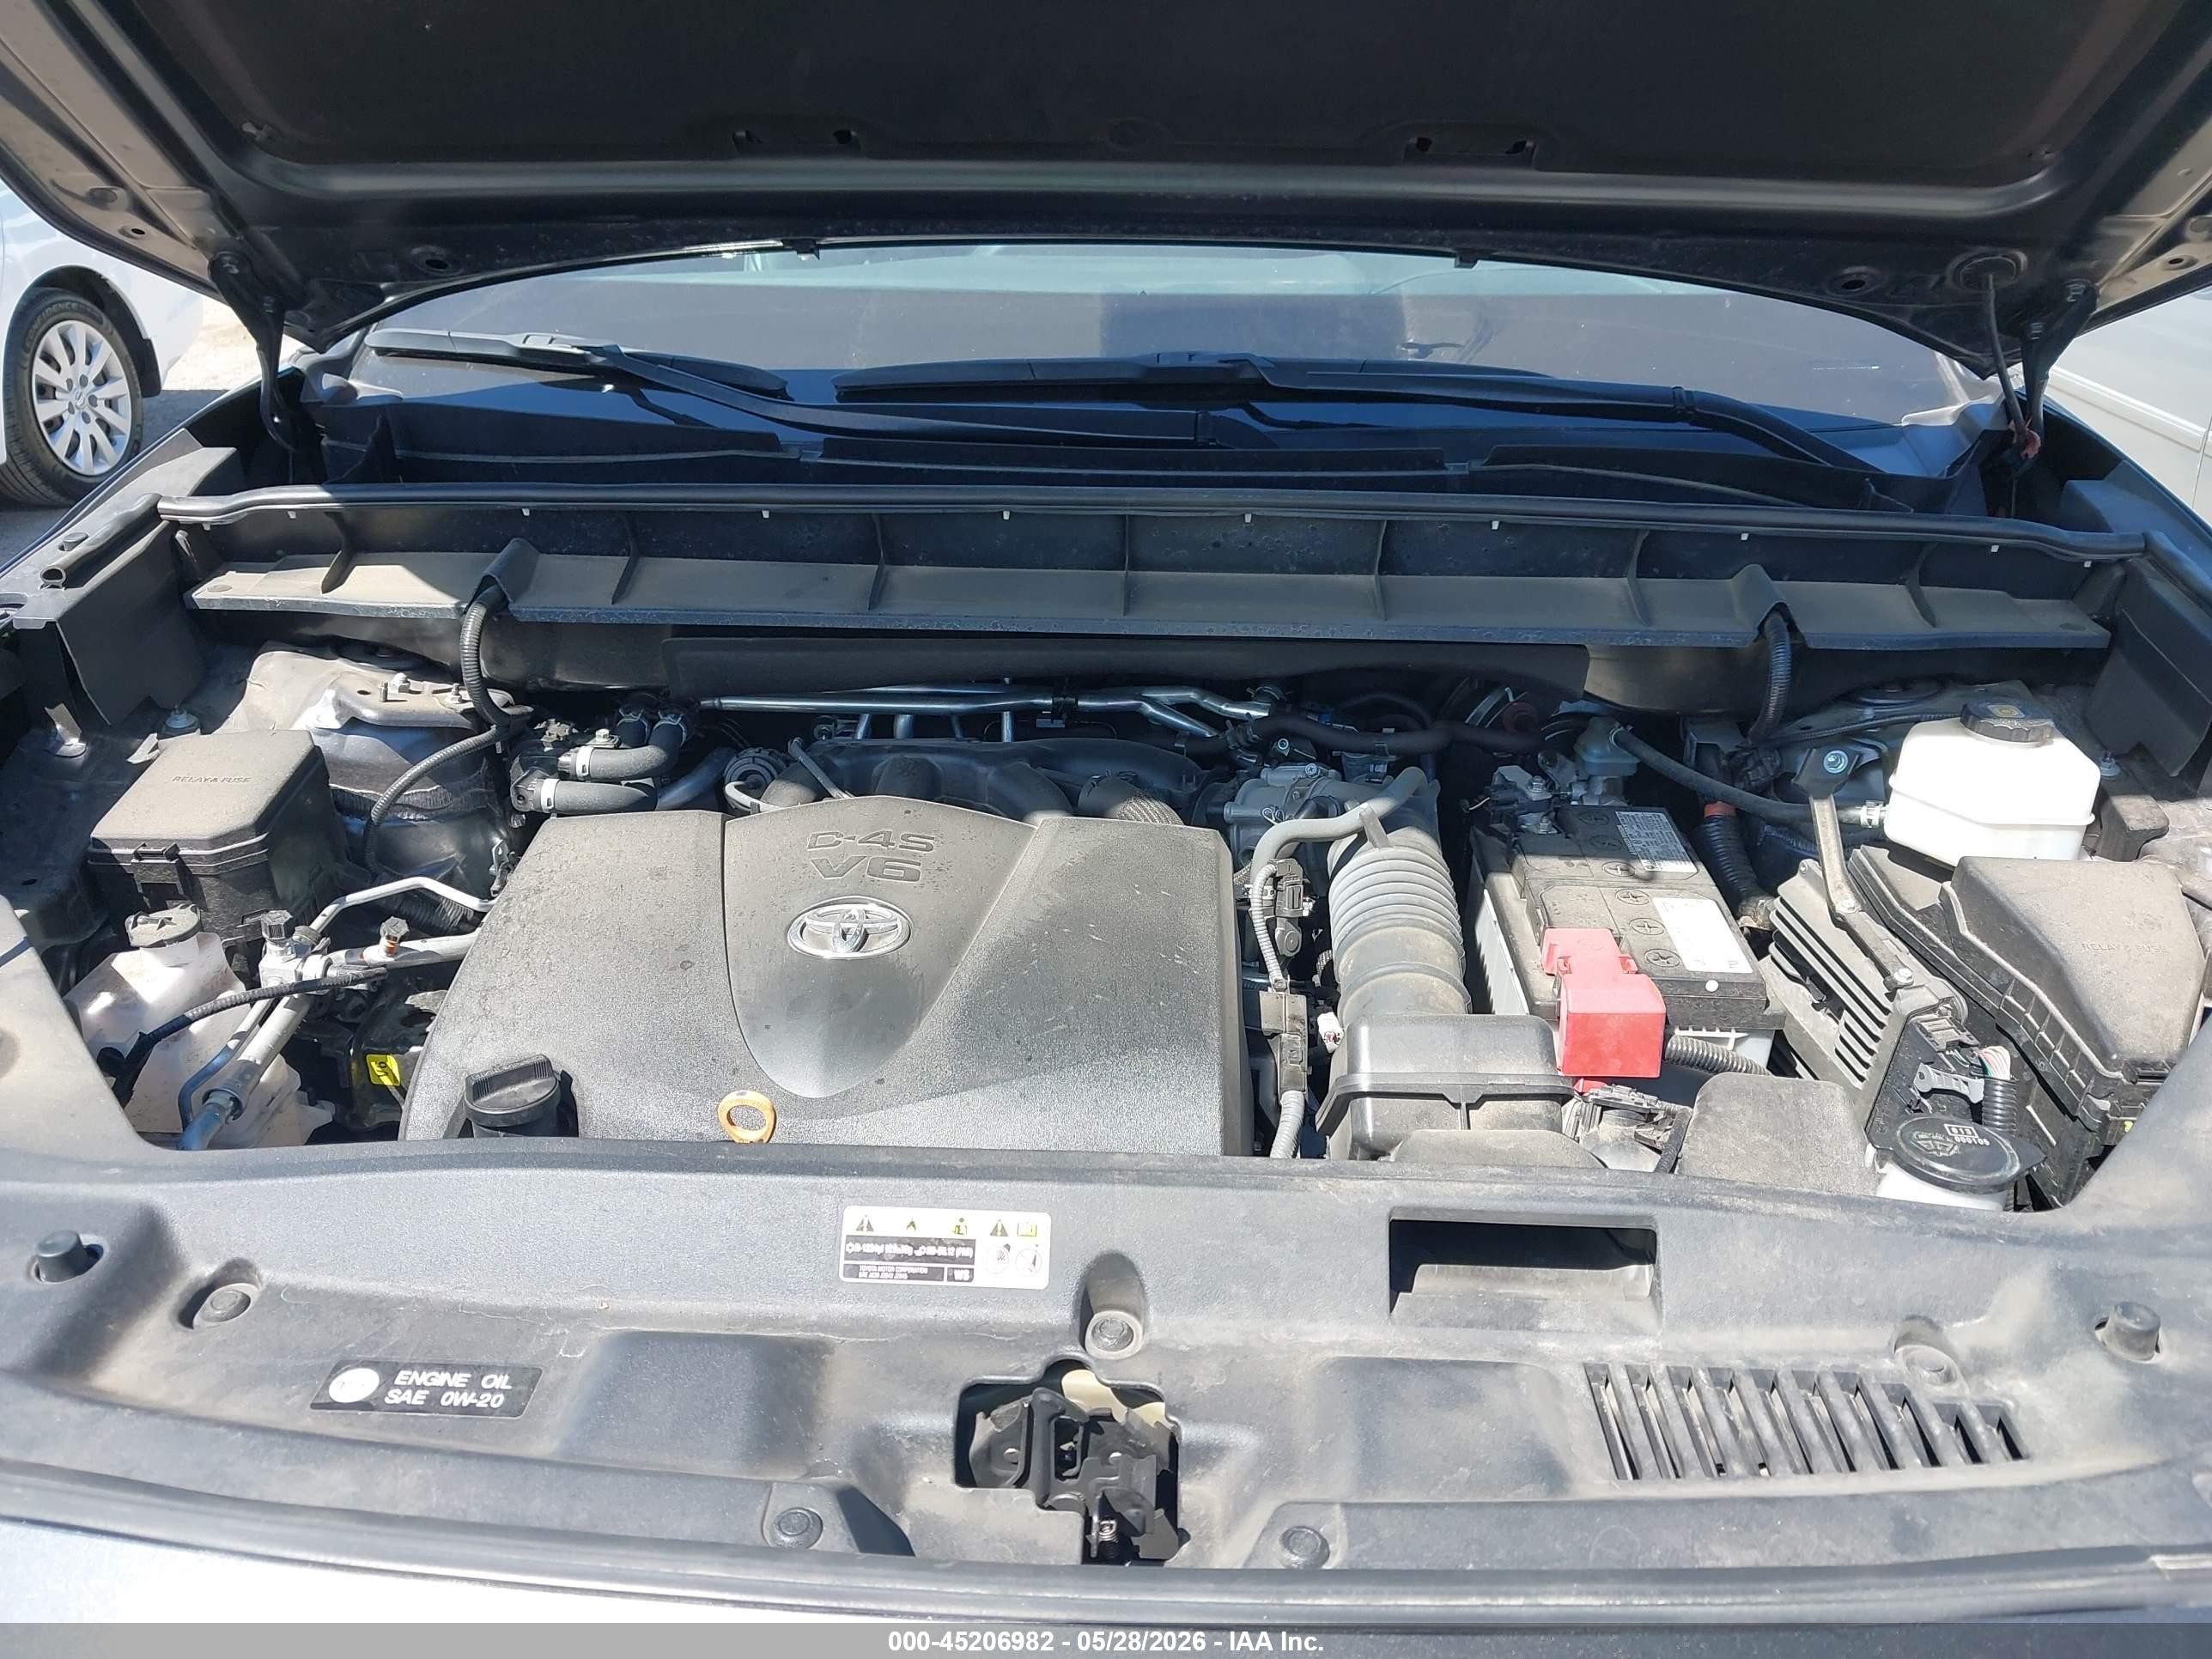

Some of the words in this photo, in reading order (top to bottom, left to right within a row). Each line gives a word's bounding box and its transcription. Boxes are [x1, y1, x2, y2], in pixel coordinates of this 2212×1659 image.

[807, 830, 936, 853] D-4S
[810, 855, 922, 883] V6
[394, 1370, 472, 1388] ENGINE
[481, 1374, 513, 1389] OIL
[384, 1389, 429, 1405] SAE
[440, 1391, 505, 1408] 0W-20
